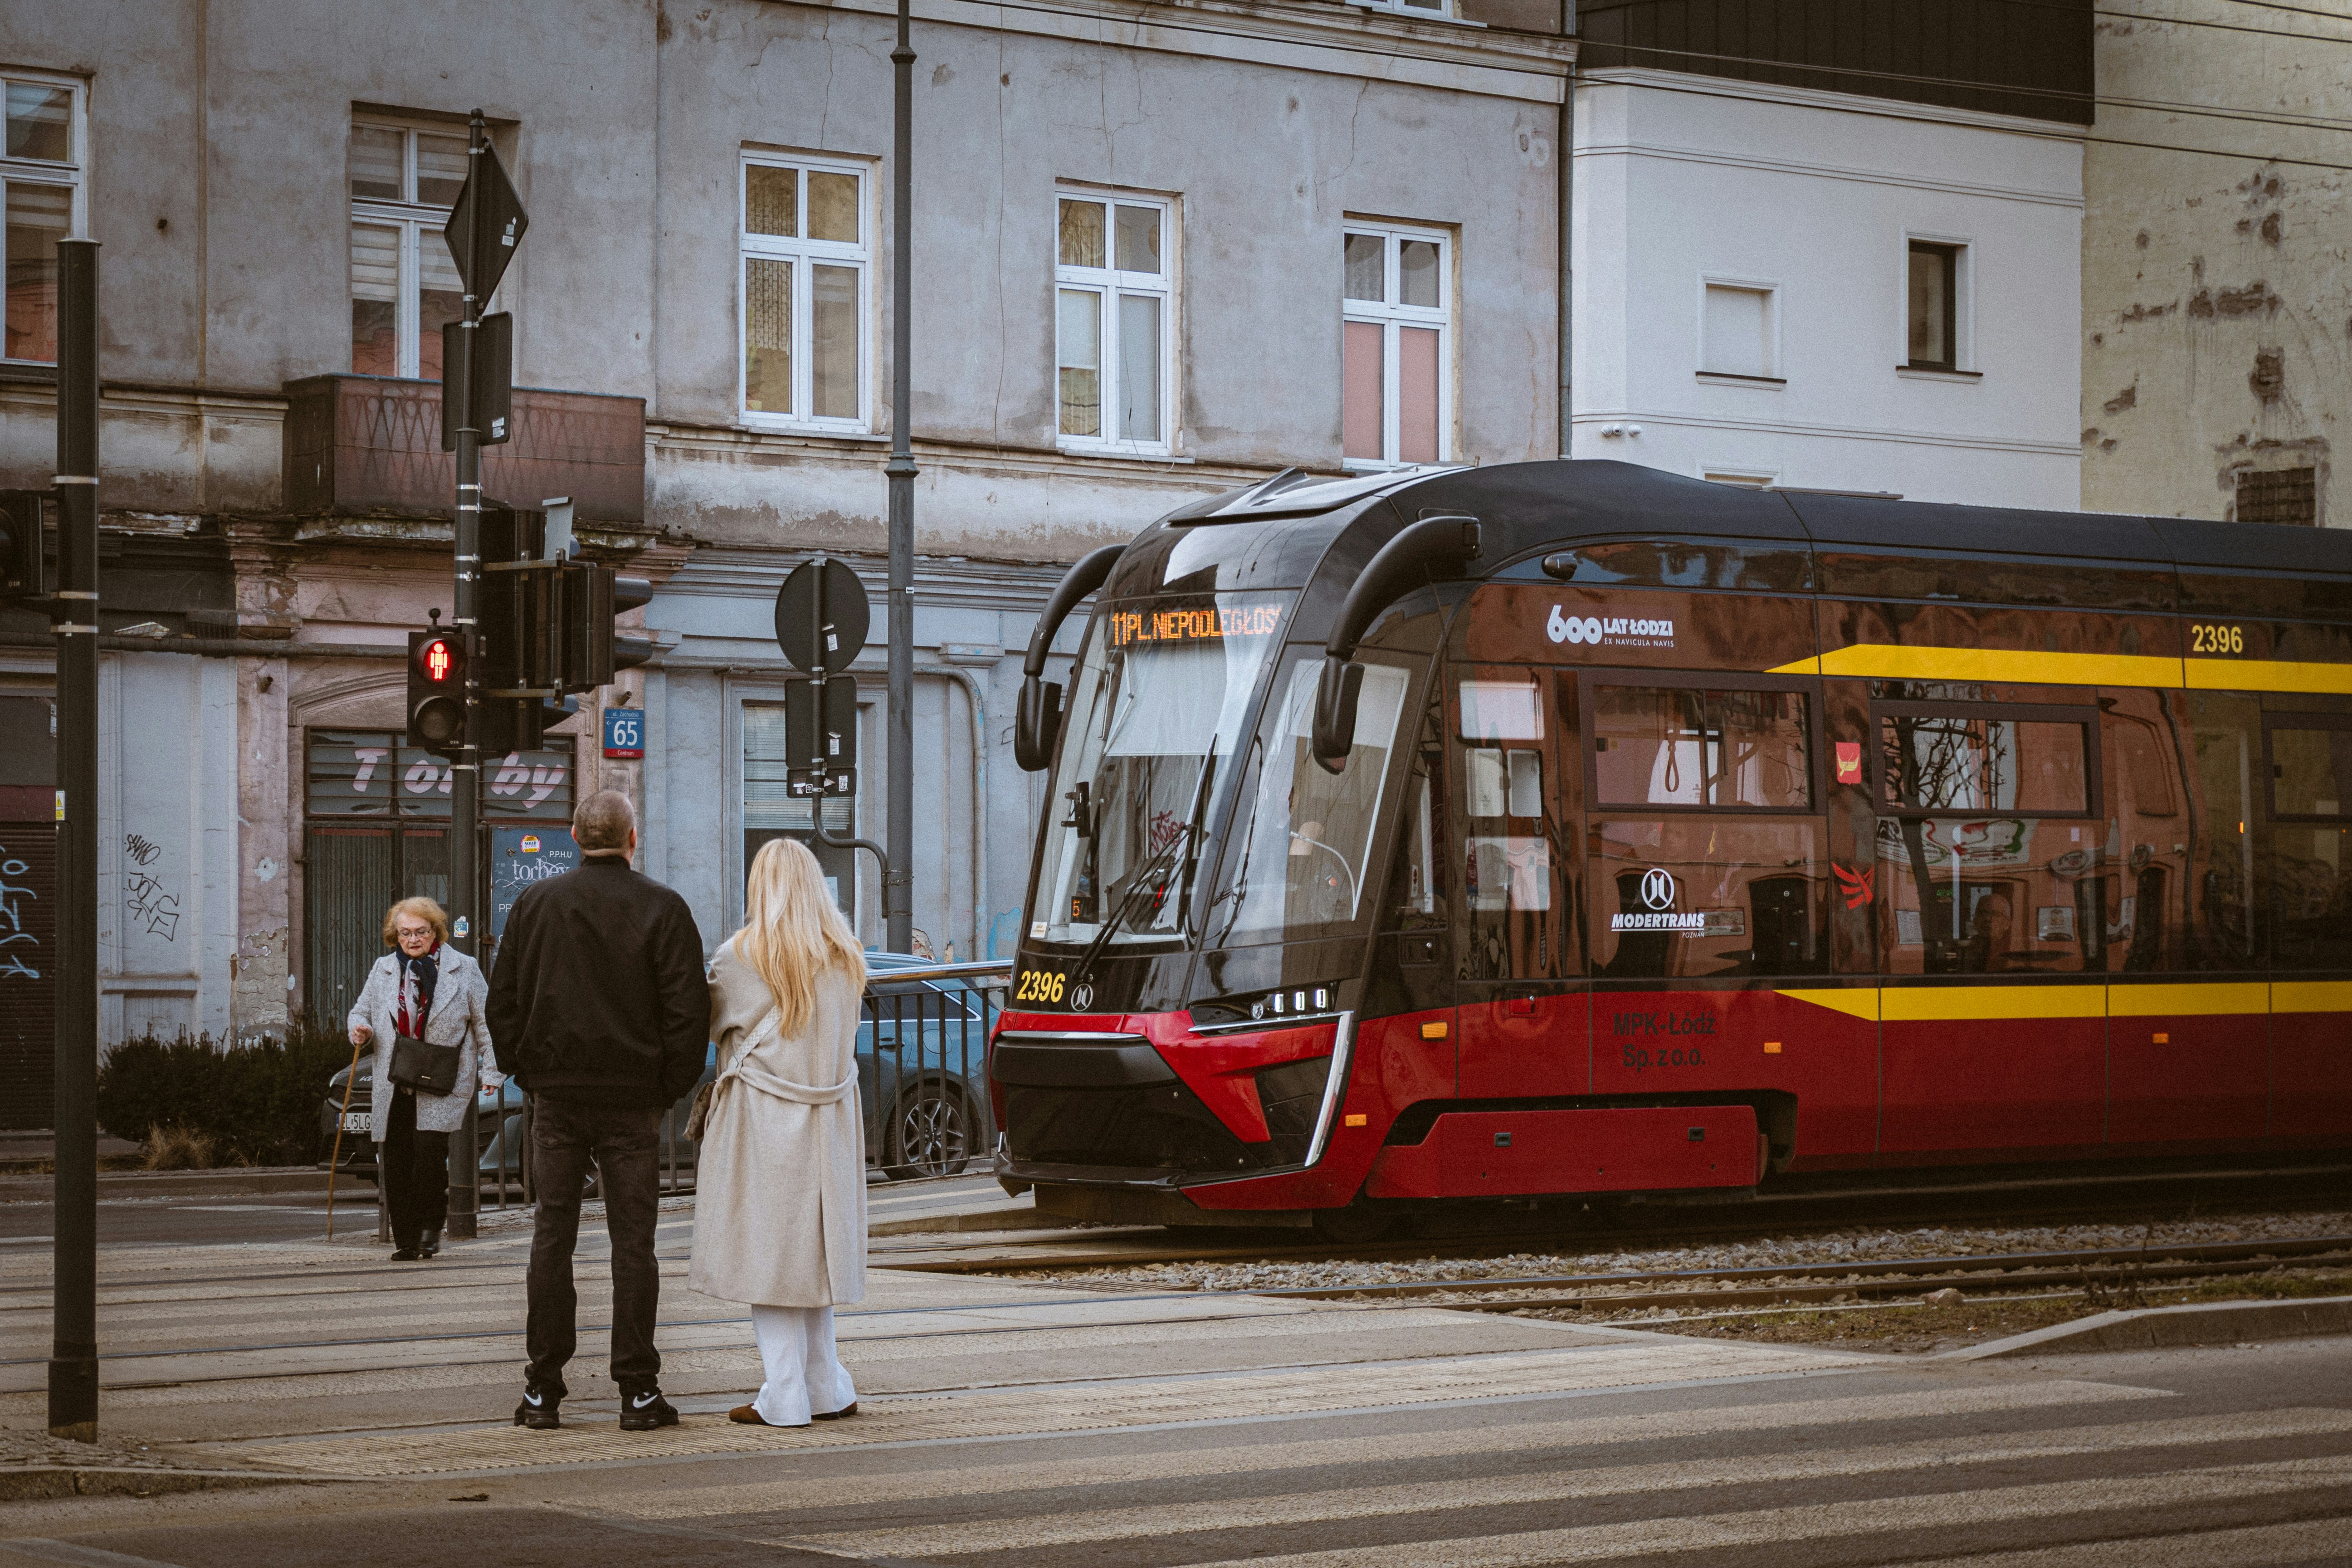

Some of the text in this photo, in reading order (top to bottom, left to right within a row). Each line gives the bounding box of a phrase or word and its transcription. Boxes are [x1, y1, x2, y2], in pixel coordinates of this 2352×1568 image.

[1153, 605, 1283, 640] NIEPODLEGŁOŚ
[1547, 605, 1674, 644] 600 LAT ŁODZI
[1615, 638, 1650, 647] NAVICULA
[1654, 639, 1674, 647] NAVIS
[2192, 625, 2243, 653] 2396
[614, 720, 638, 746] 65
[1073, 900, 1080, 917] 5
[1611, 913, 1705, 928] MODERTRANS
[1016, 970, 1066, 1003] 2396
[1614, 1011, 1716, 1036] MPK-Łódź
[1623, 1043, 1706, 1073] Sp. z o.o.
[354, 1114, 372, 1129] 5LG
